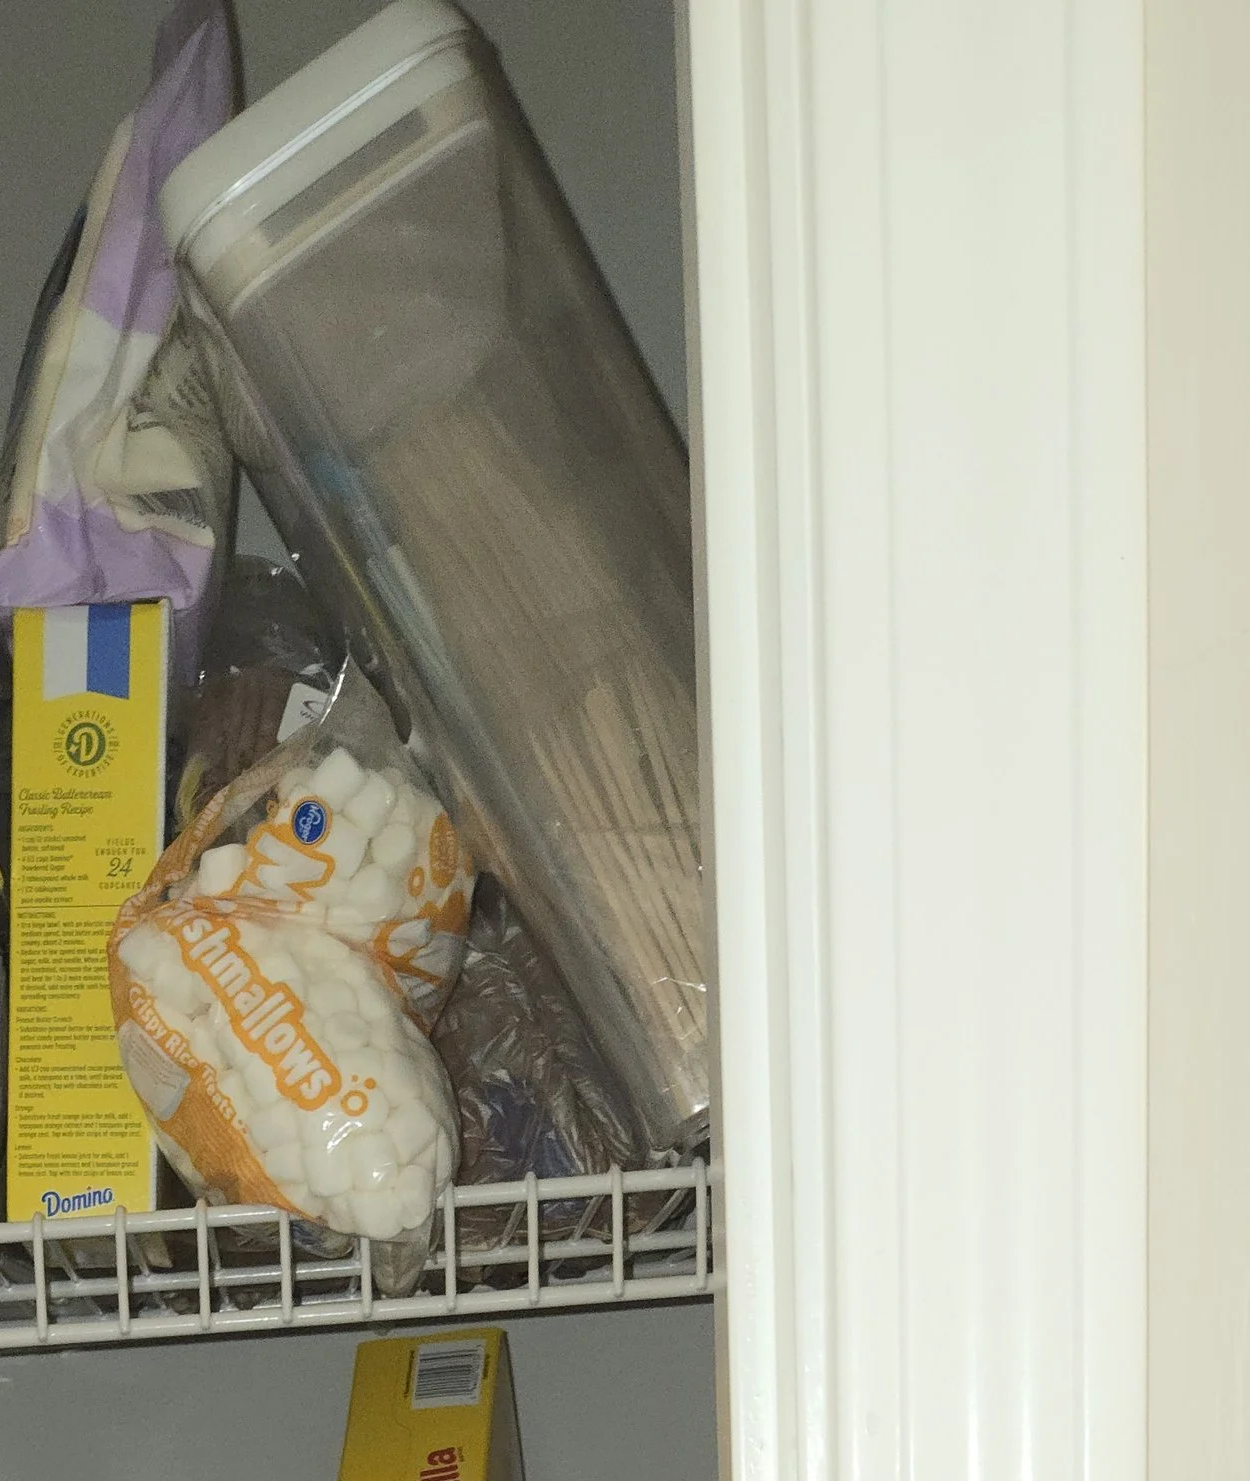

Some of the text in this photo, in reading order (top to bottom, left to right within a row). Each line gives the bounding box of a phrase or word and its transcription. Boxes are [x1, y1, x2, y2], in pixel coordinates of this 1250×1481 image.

[106, 857, 133, 877] 24
[129, 986, 234, 1121] Crispy Rice Treats
[41, 1187, 114, 1218] Domino
